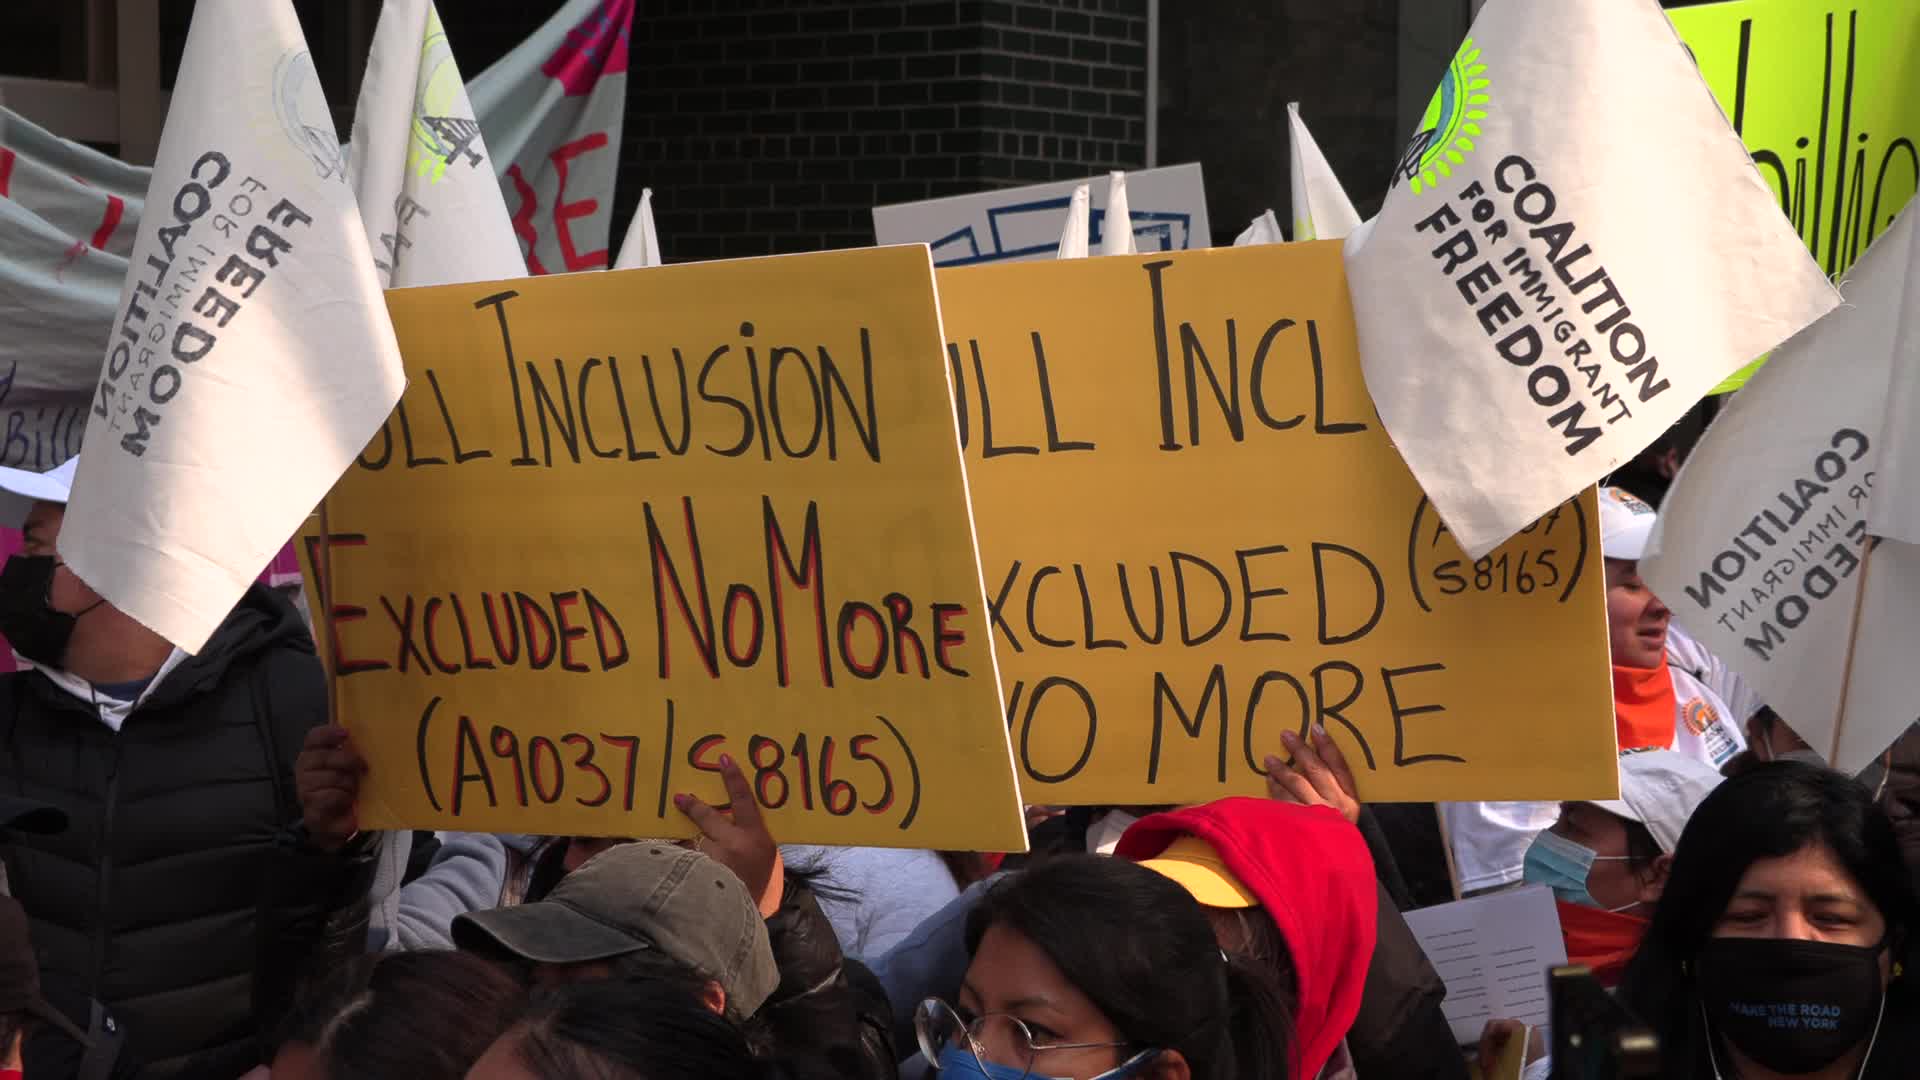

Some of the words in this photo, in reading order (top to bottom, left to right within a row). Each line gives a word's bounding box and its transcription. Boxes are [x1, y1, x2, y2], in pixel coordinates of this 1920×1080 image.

[1142, 260, 1368, 452] INCL
[1414, 203, 1603, 456] FREEDOM
[1458, 180, 1508, 245] FOR
[1502, 247, 1632, 425] IMMIGRANT
[1494, 155, 1671, 403] COALITION
[0, 405, 83, 467] Bill
[304, 533, 630, 677] EXCLUDED
[643, 496, 765, 680] NO
[762, 495, 970, 689] MORE
[1147, 660, 1467, 785] MORE
[1768, 1004, 1799, 1016] THE
[1800, 1003, 1841, 1017] ROAD
[1768, 1018, 1799, 1028] NEW
[1801, 1018, 1840, 1030] YORK
